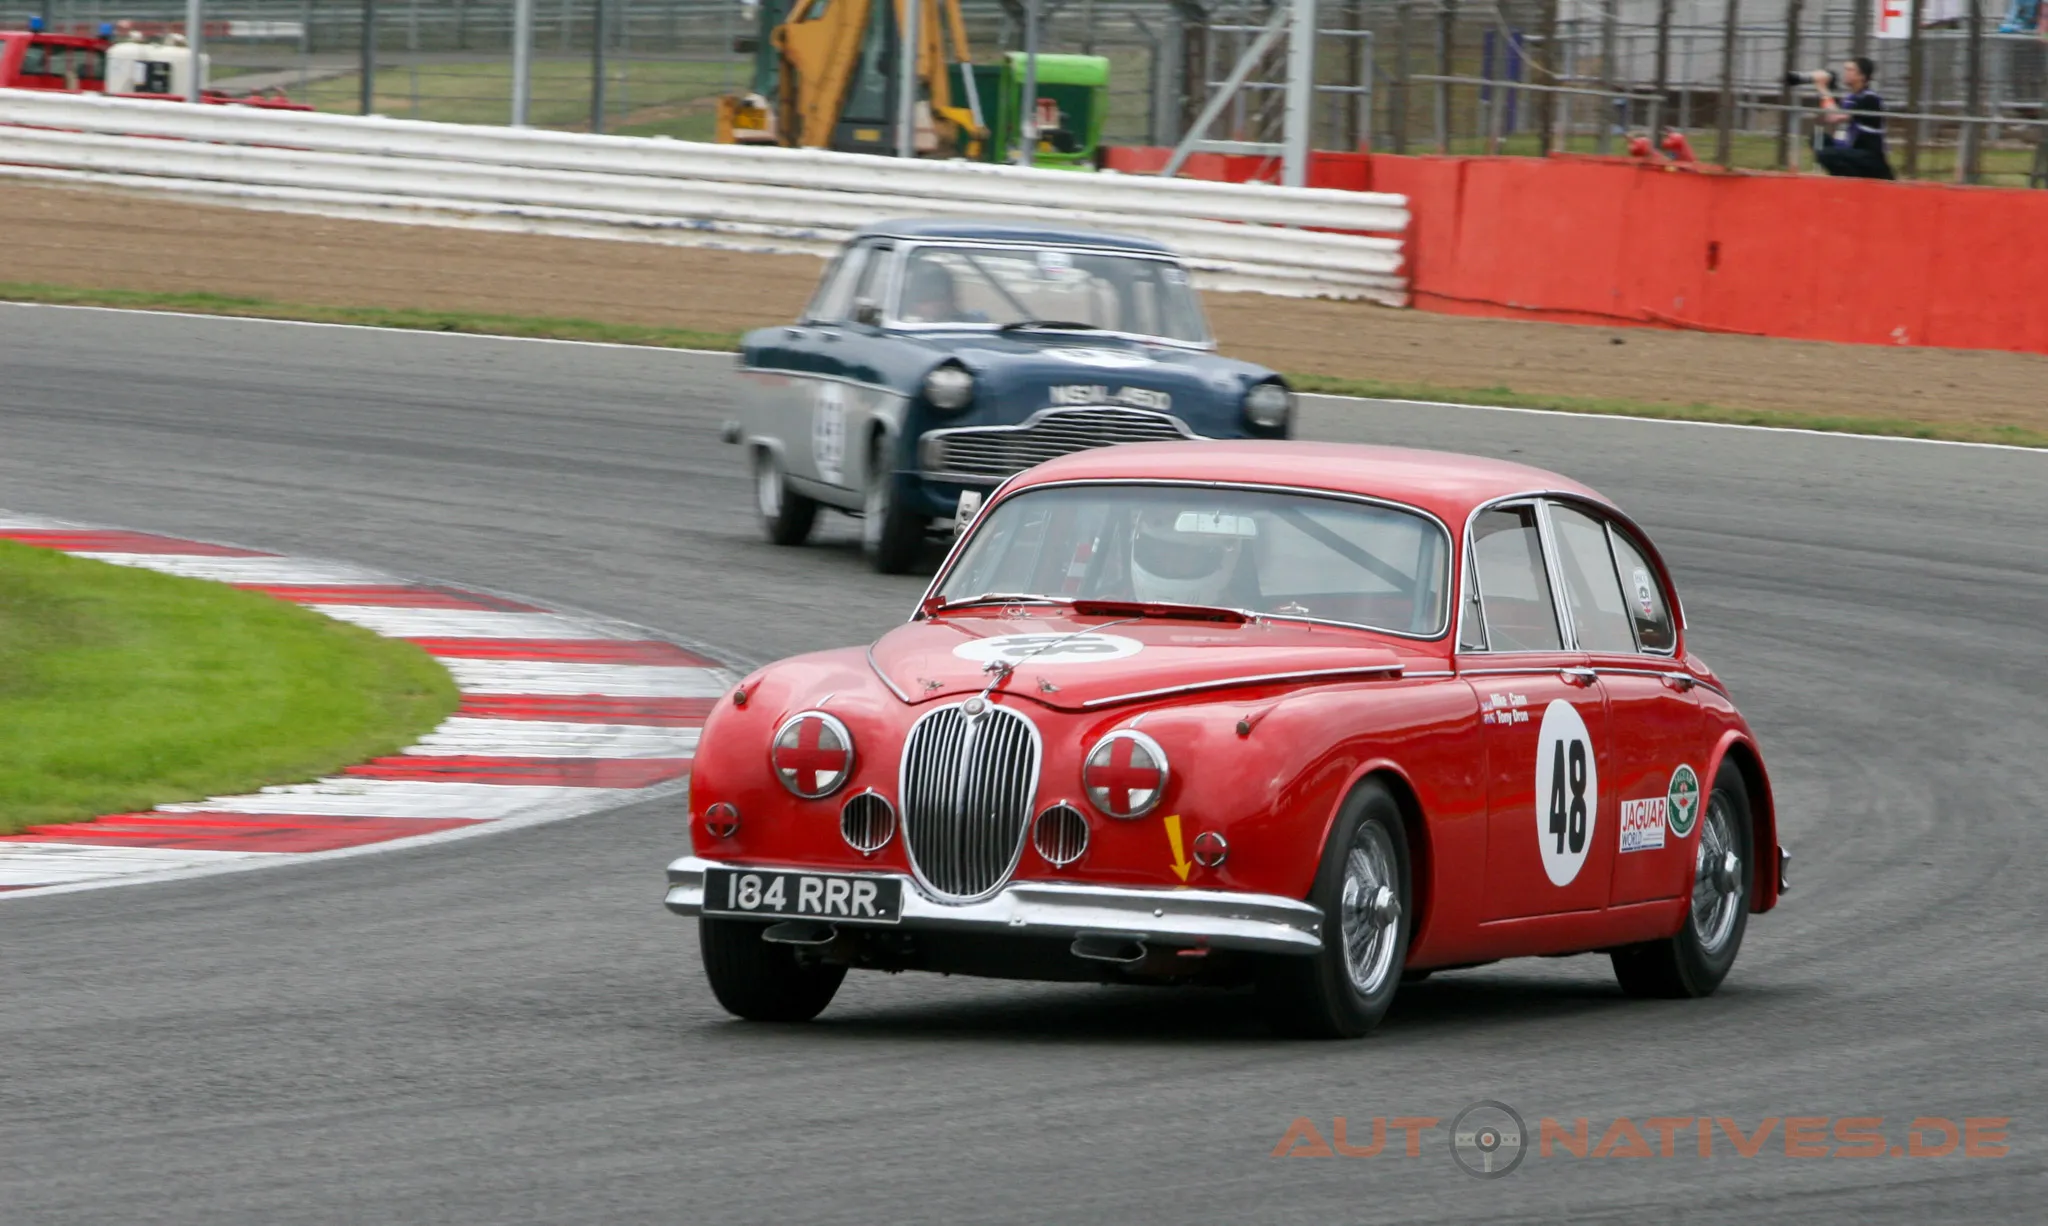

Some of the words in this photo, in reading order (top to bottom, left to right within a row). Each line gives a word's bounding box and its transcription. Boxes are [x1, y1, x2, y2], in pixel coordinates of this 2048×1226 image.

[1496, 709, 1512, 726] Tony
[1549, 739, 1587, 854] 48
[1622, 799, 1664, 832] JAGUAR
[1622, 831, 1643, 847] WORLD
[728, 873, 787, 912] 184
[798, 877, 878, 917] RRR
